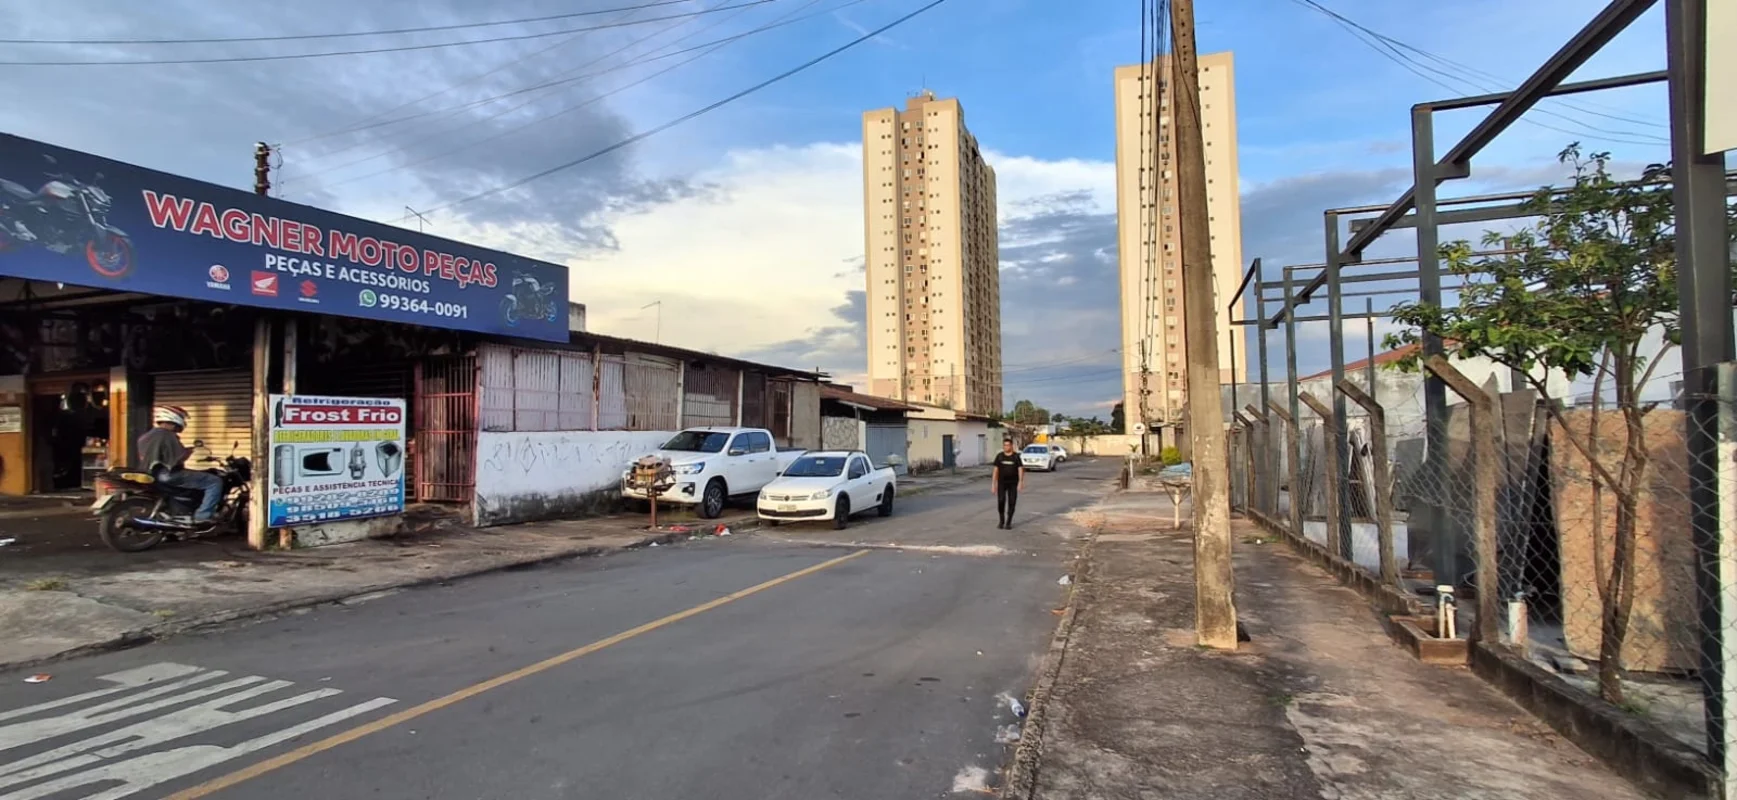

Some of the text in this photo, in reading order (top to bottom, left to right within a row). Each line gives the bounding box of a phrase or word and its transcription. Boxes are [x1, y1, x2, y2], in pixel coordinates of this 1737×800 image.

[142, 190, 498, 289] WAGNER MOTO PEÇAS
[265, 253, 431, 294] PEÇAS E ACESSÓRIOS
[379, 293, 468, 319] 99364-0091
[285, 407, 399, 421] Frost Frio
[273, 486, 303, 494] PEÇAS
